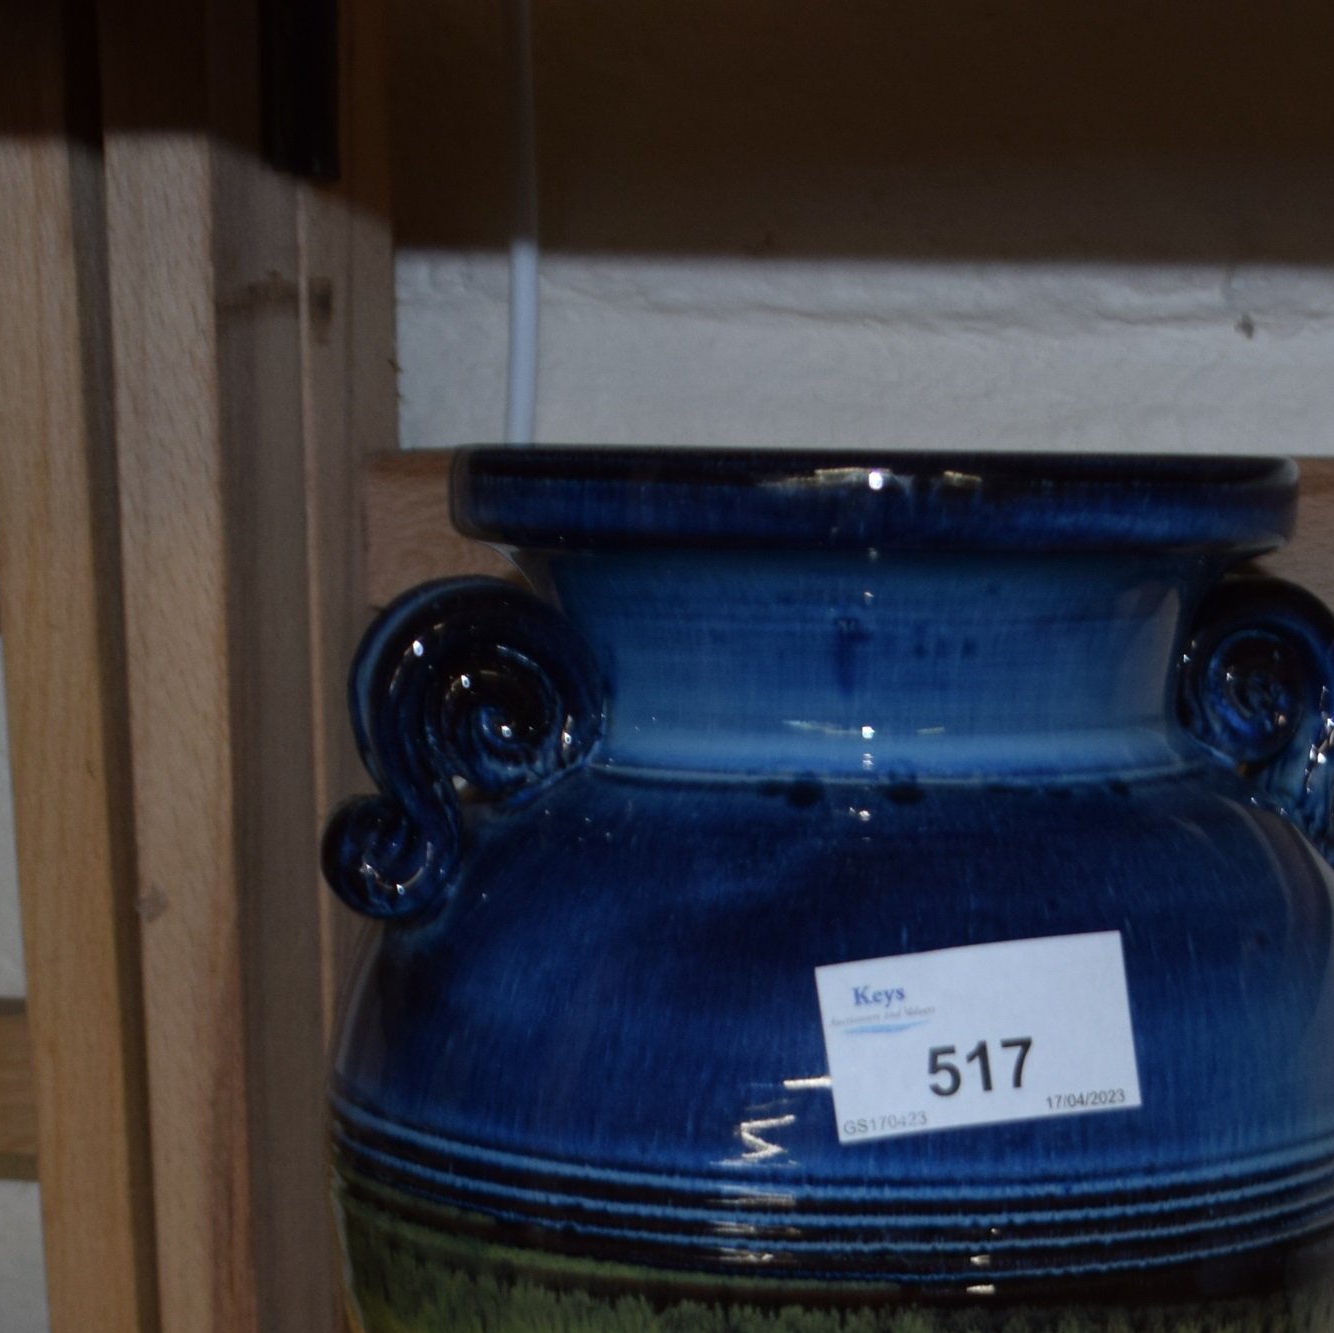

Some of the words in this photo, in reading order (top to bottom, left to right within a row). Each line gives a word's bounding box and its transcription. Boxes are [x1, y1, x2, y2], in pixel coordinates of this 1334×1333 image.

[853, 985, 905, 1007] Keys
[928, 1037, 1032, 1096] 517
[1046, 1089, 1125, 1109] 17/04/2023
[843, 1111, 927, 1136] GS170423
